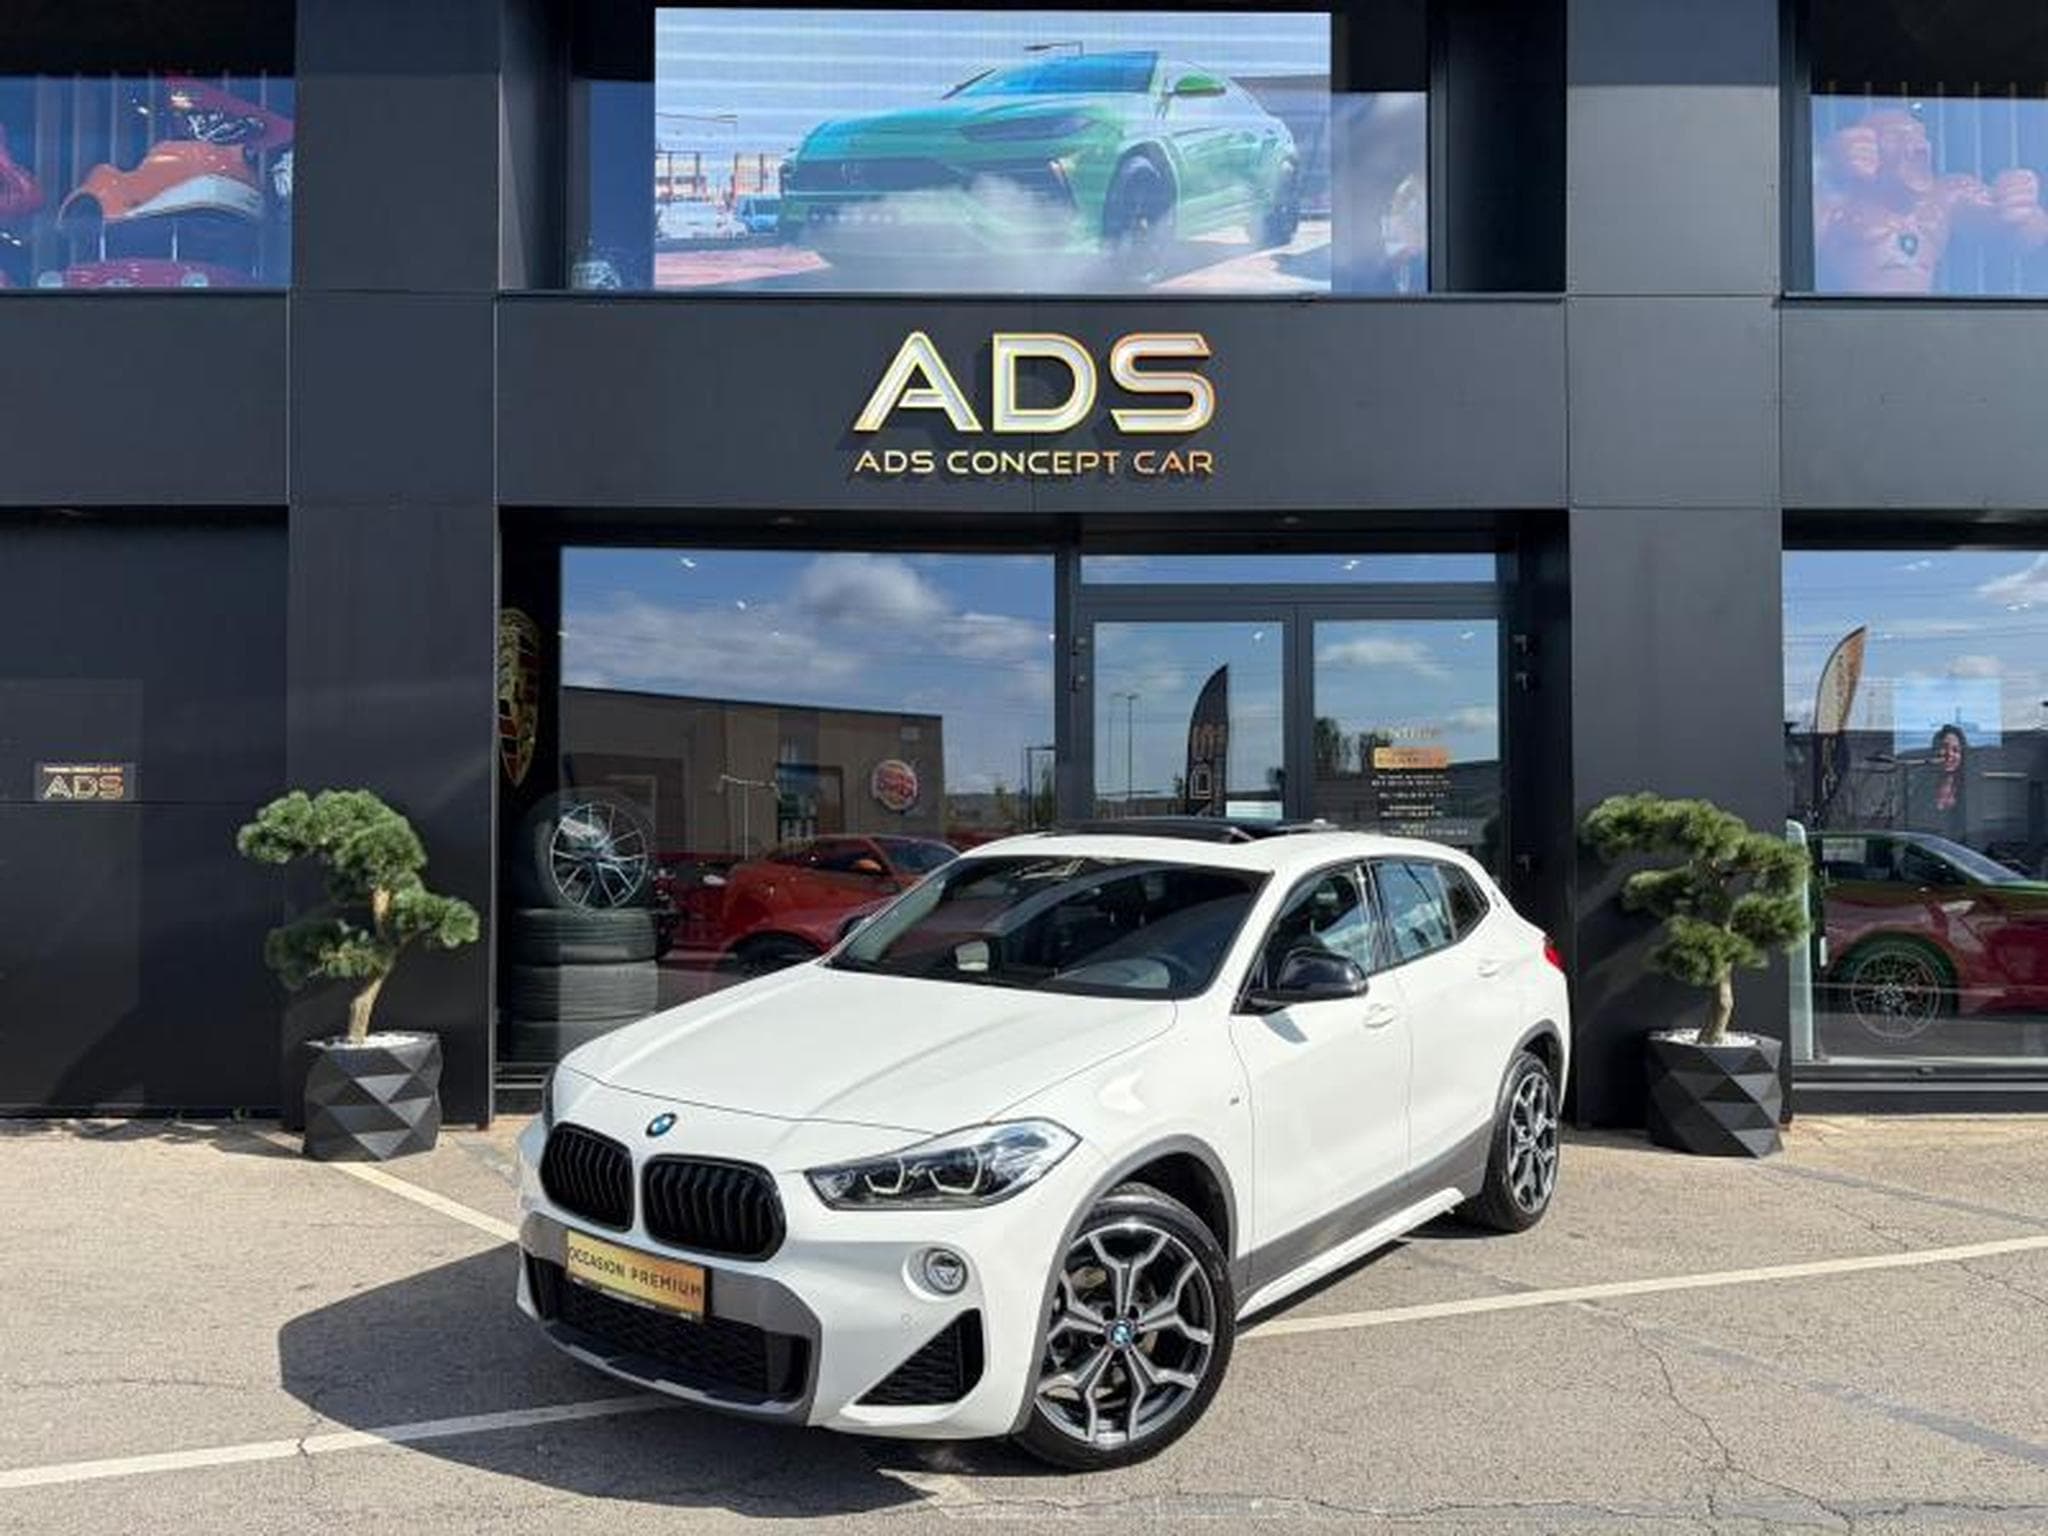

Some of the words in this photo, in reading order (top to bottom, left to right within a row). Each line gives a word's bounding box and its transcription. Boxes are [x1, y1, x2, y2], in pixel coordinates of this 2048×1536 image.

[853, 331, 1215, 433] ADS
[854, 450, 935, 474] ADS
[946, 450, 1120, 474] CONCEPT
[1133, 450, 1214, 474] CAR
[44, 775, 124, 800] ADS
[568, 1246, 626, 1278] OCCASION
[630, 1266, 702, 1299] PREMIUM
